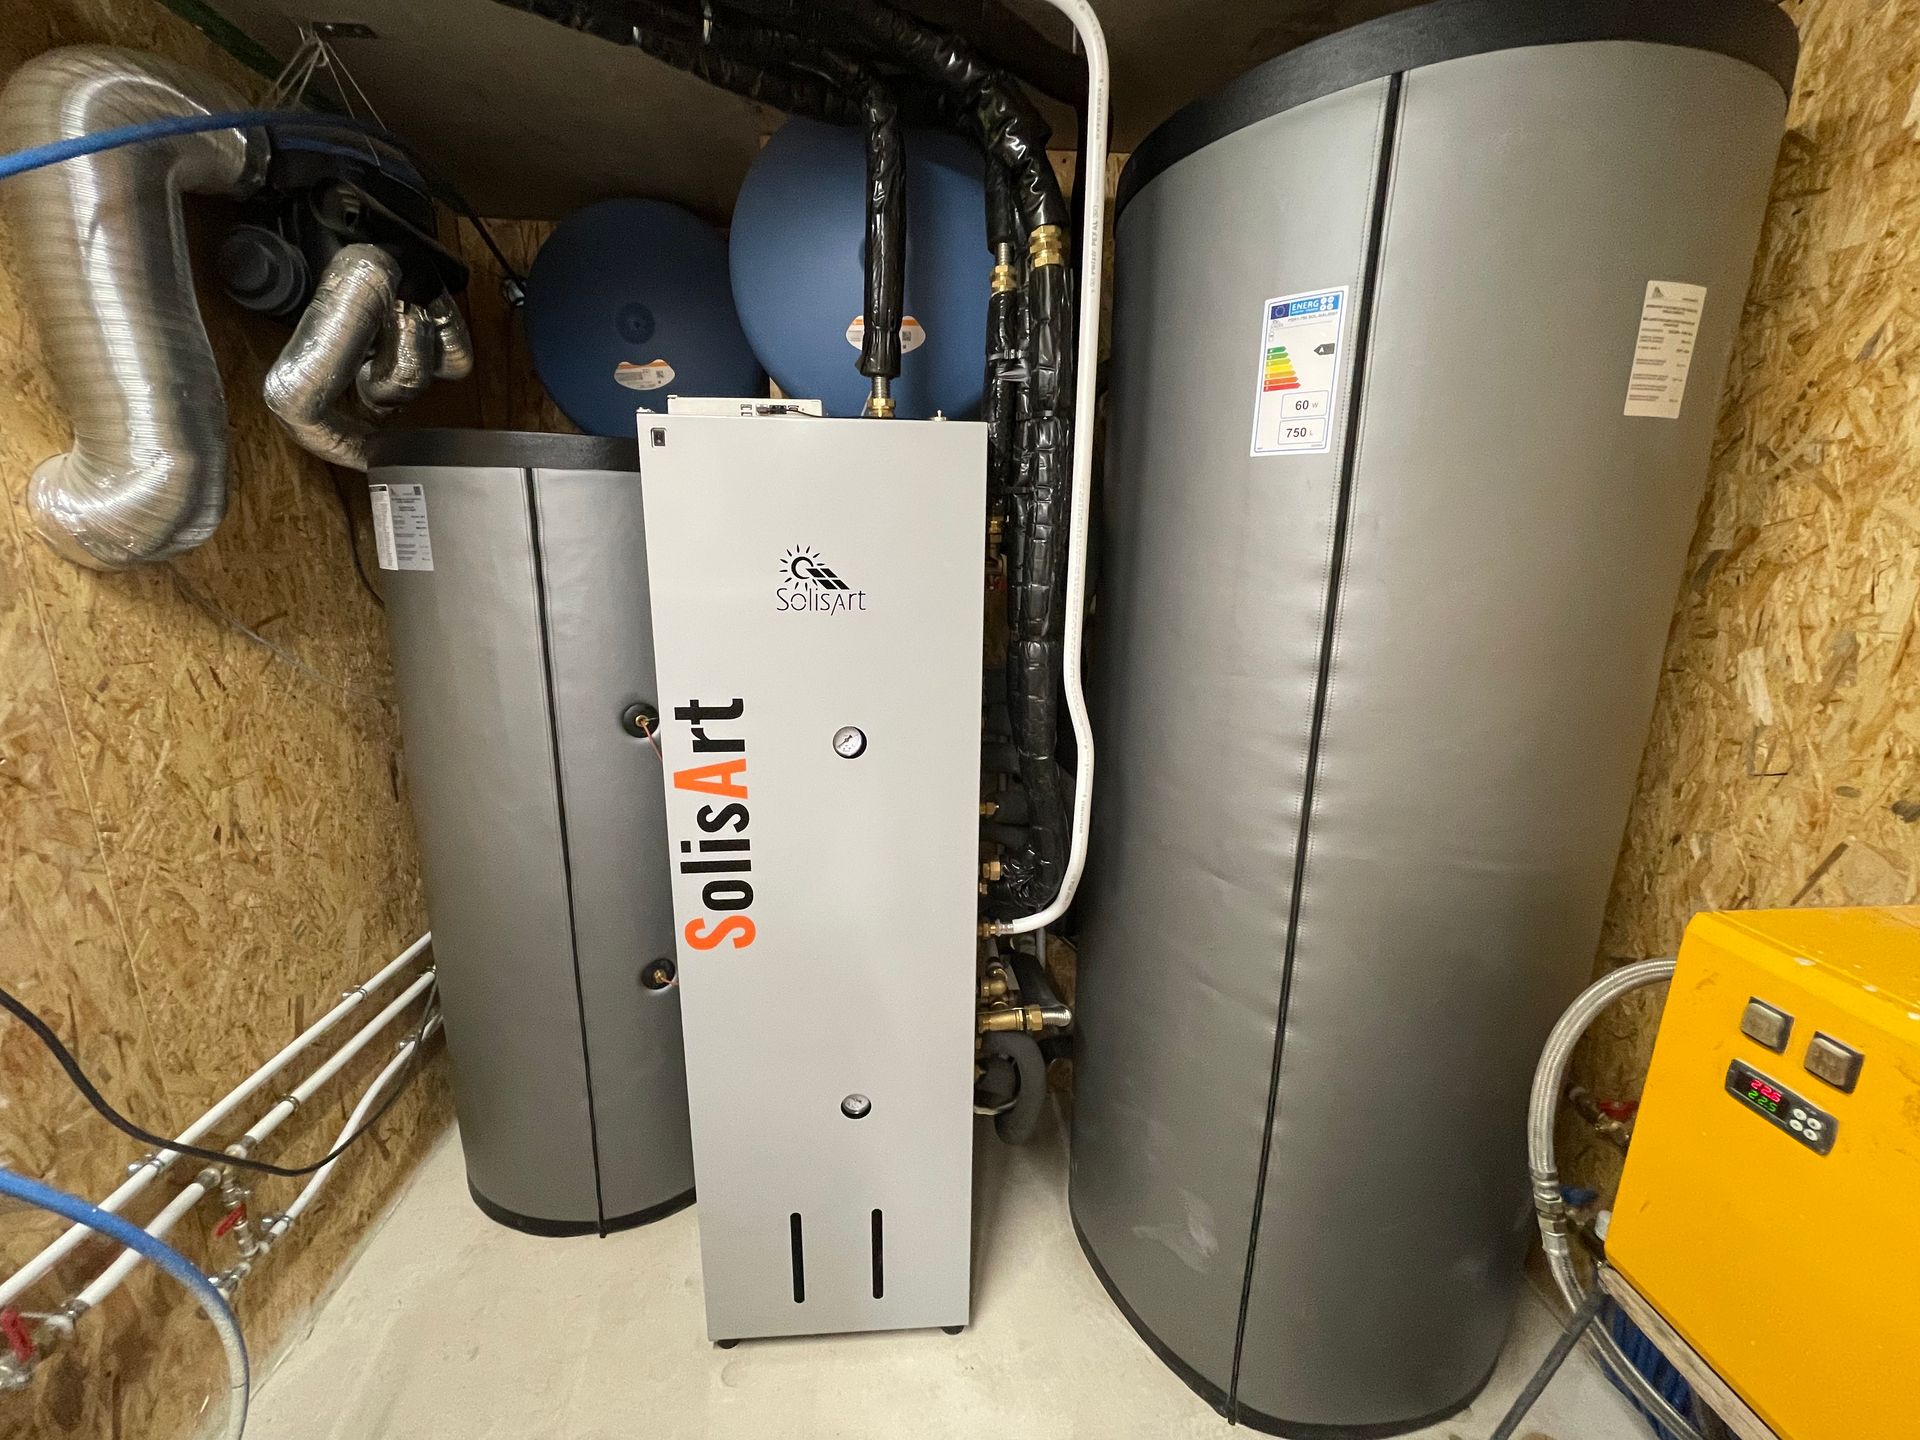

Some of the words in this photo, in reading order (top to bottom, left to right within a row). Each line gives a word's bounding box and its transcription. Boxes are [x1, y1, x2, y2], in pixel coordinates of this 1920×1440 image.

[1292, 299, 1319, 311] ENERG
[1295, 400, 1309, 410] 60
[1286, 427, 1307, 438] 750
[776, 587, 866, 616] SolisArt
[674, 698, 756, 950] SolisArt
